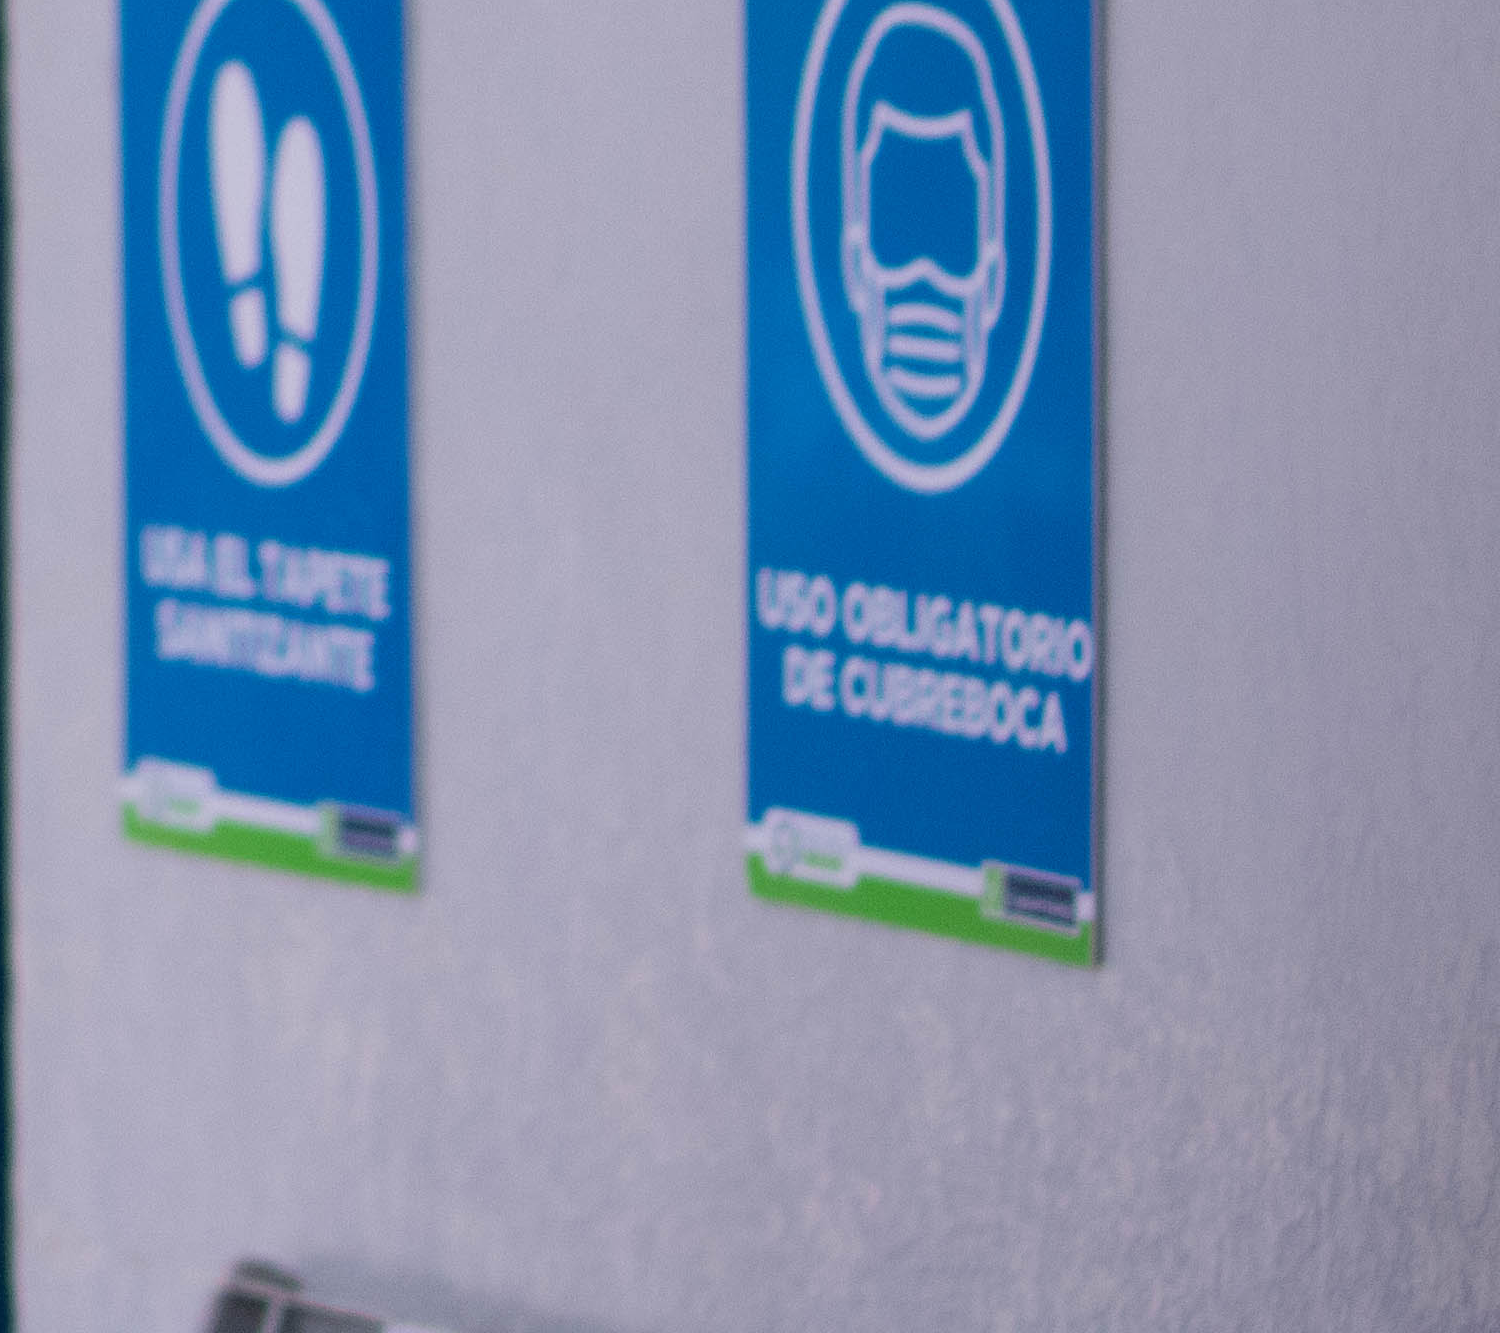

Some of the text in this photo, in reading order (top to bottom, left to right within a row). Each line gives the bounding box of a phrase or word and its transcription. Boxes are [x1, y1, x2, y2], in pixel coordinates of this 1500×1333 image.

[756, 566, 1094, 683] USO OBLIGATORIO
[781, 645, 1069, 754] DE CUBREBOCA
